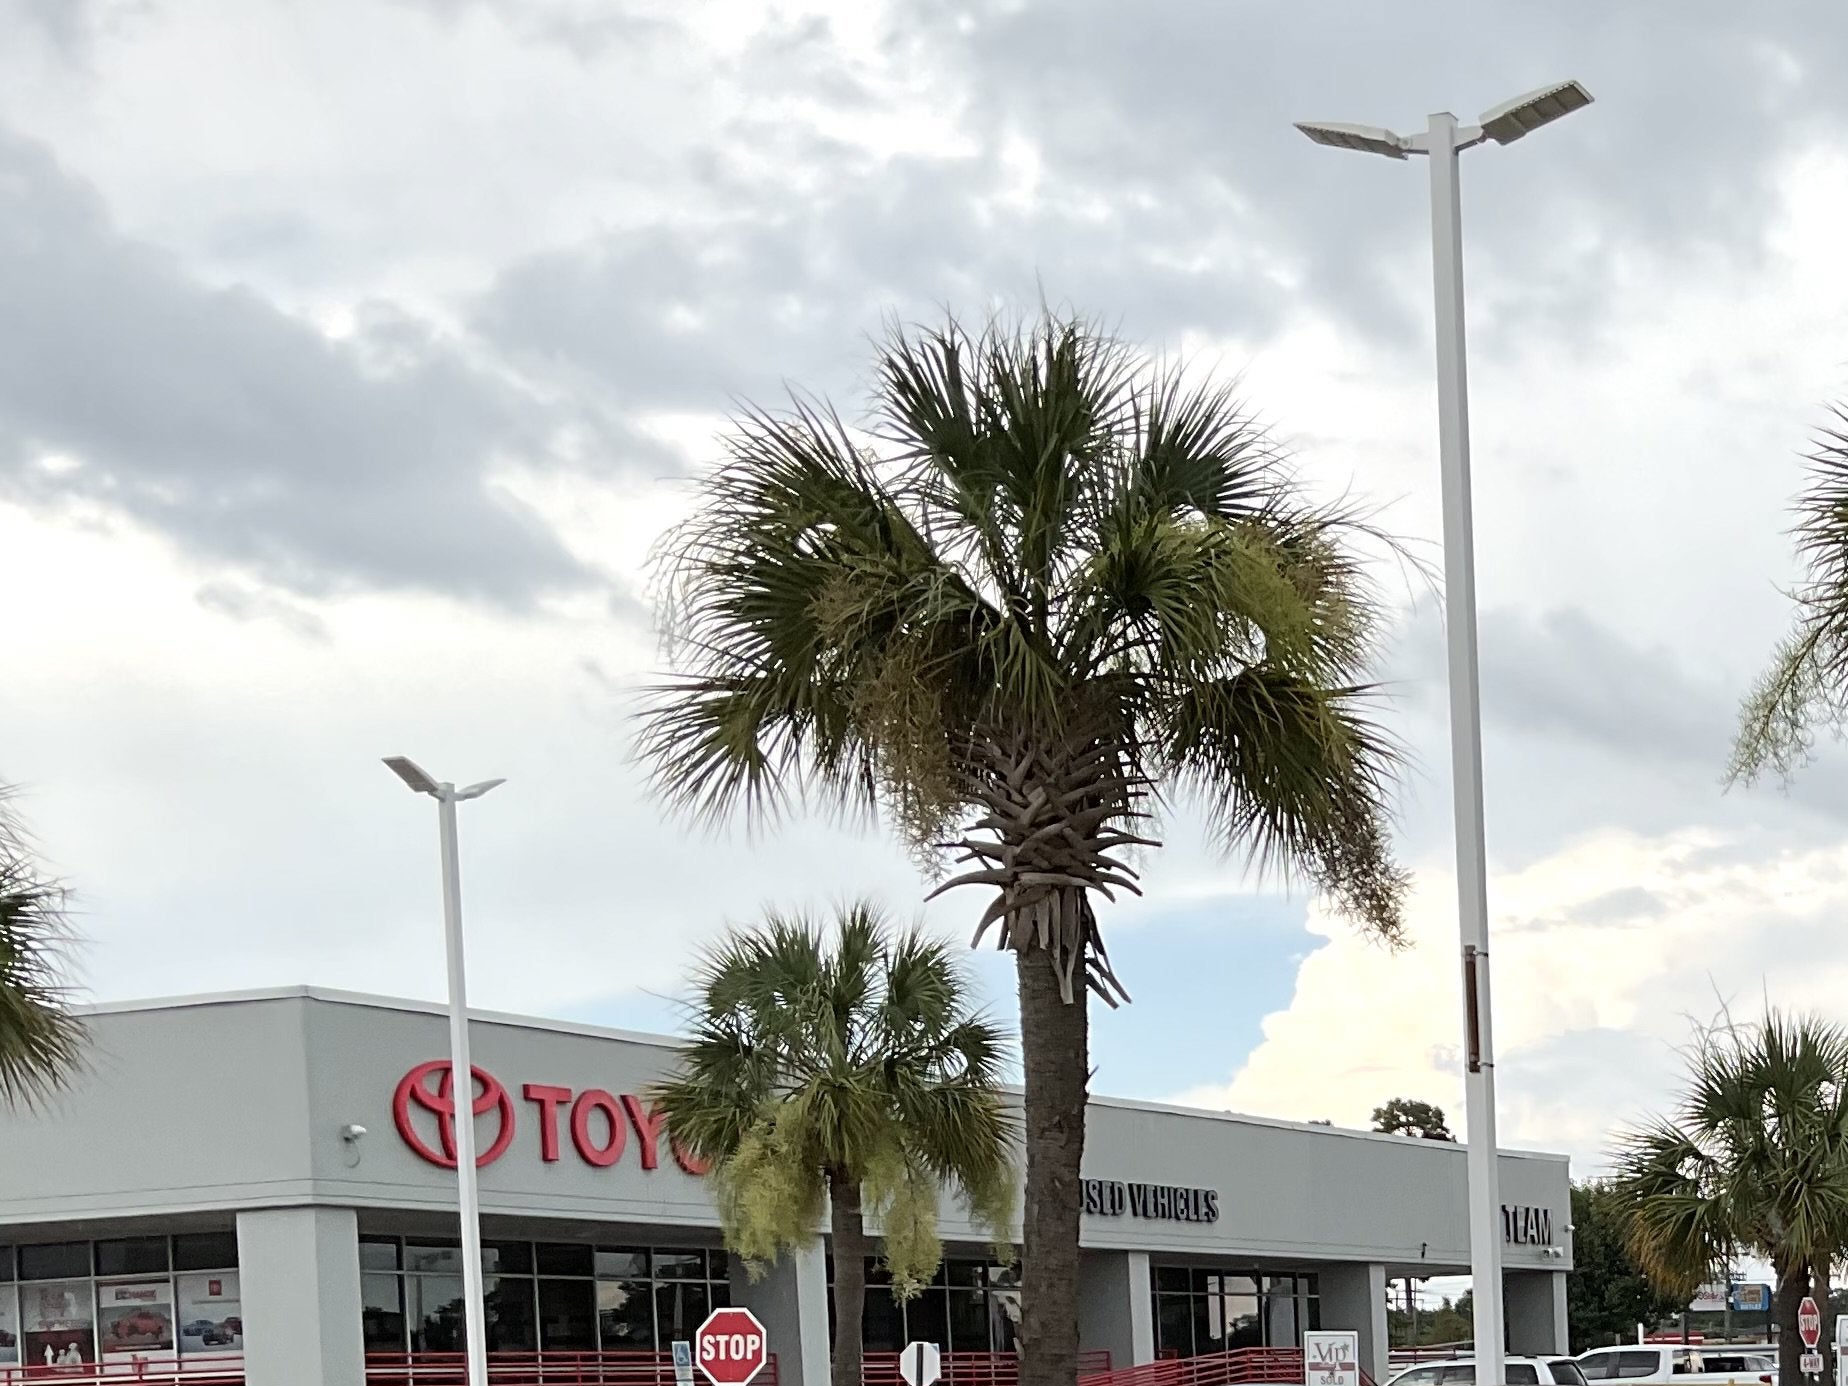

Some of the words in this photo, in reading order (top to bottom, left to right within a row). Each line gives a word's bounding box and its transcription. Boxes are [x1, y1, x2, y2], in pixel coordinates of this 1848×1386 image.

[1128, 1183, 1219, 1222] VEHICLES
[1502, 1205, 1553, 1245] TEAM
[1800, 1314, 1818, 1331] STOP
[701, 1334, 761, 1361] STOP
[1320, 1375, 1345, 1386] SOLD
